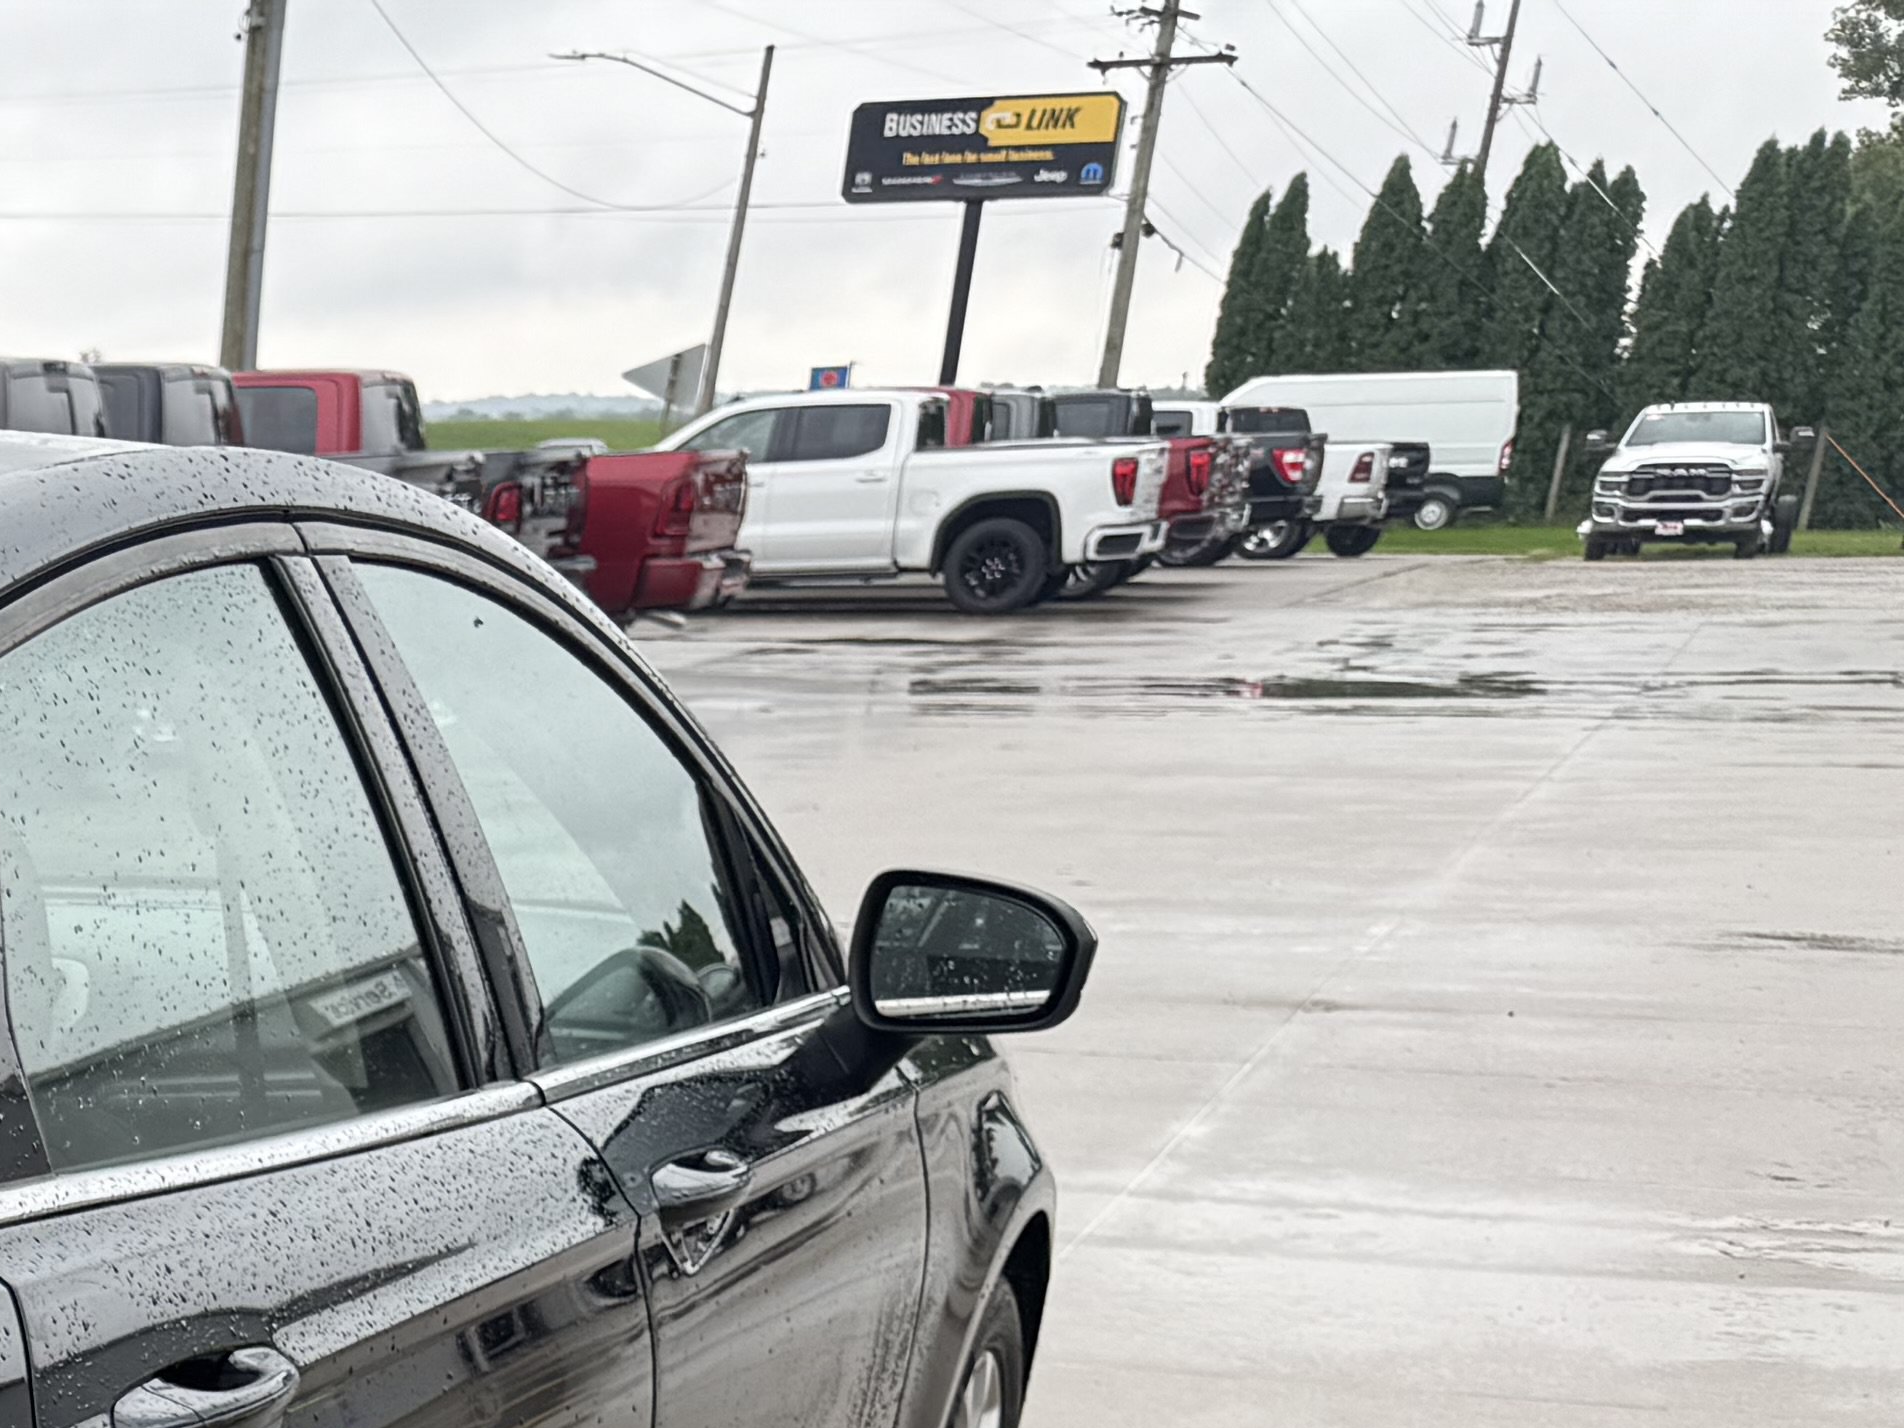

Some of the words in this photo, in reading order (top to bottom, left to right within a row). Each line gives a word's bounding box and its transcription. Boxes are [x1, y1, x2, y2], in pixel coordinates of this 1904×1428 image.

[883, 111, 978, 138] BUSINESS
[1024, 107, 1082, 131] LINK
[1033, 168, 1068, 184] Jeep
